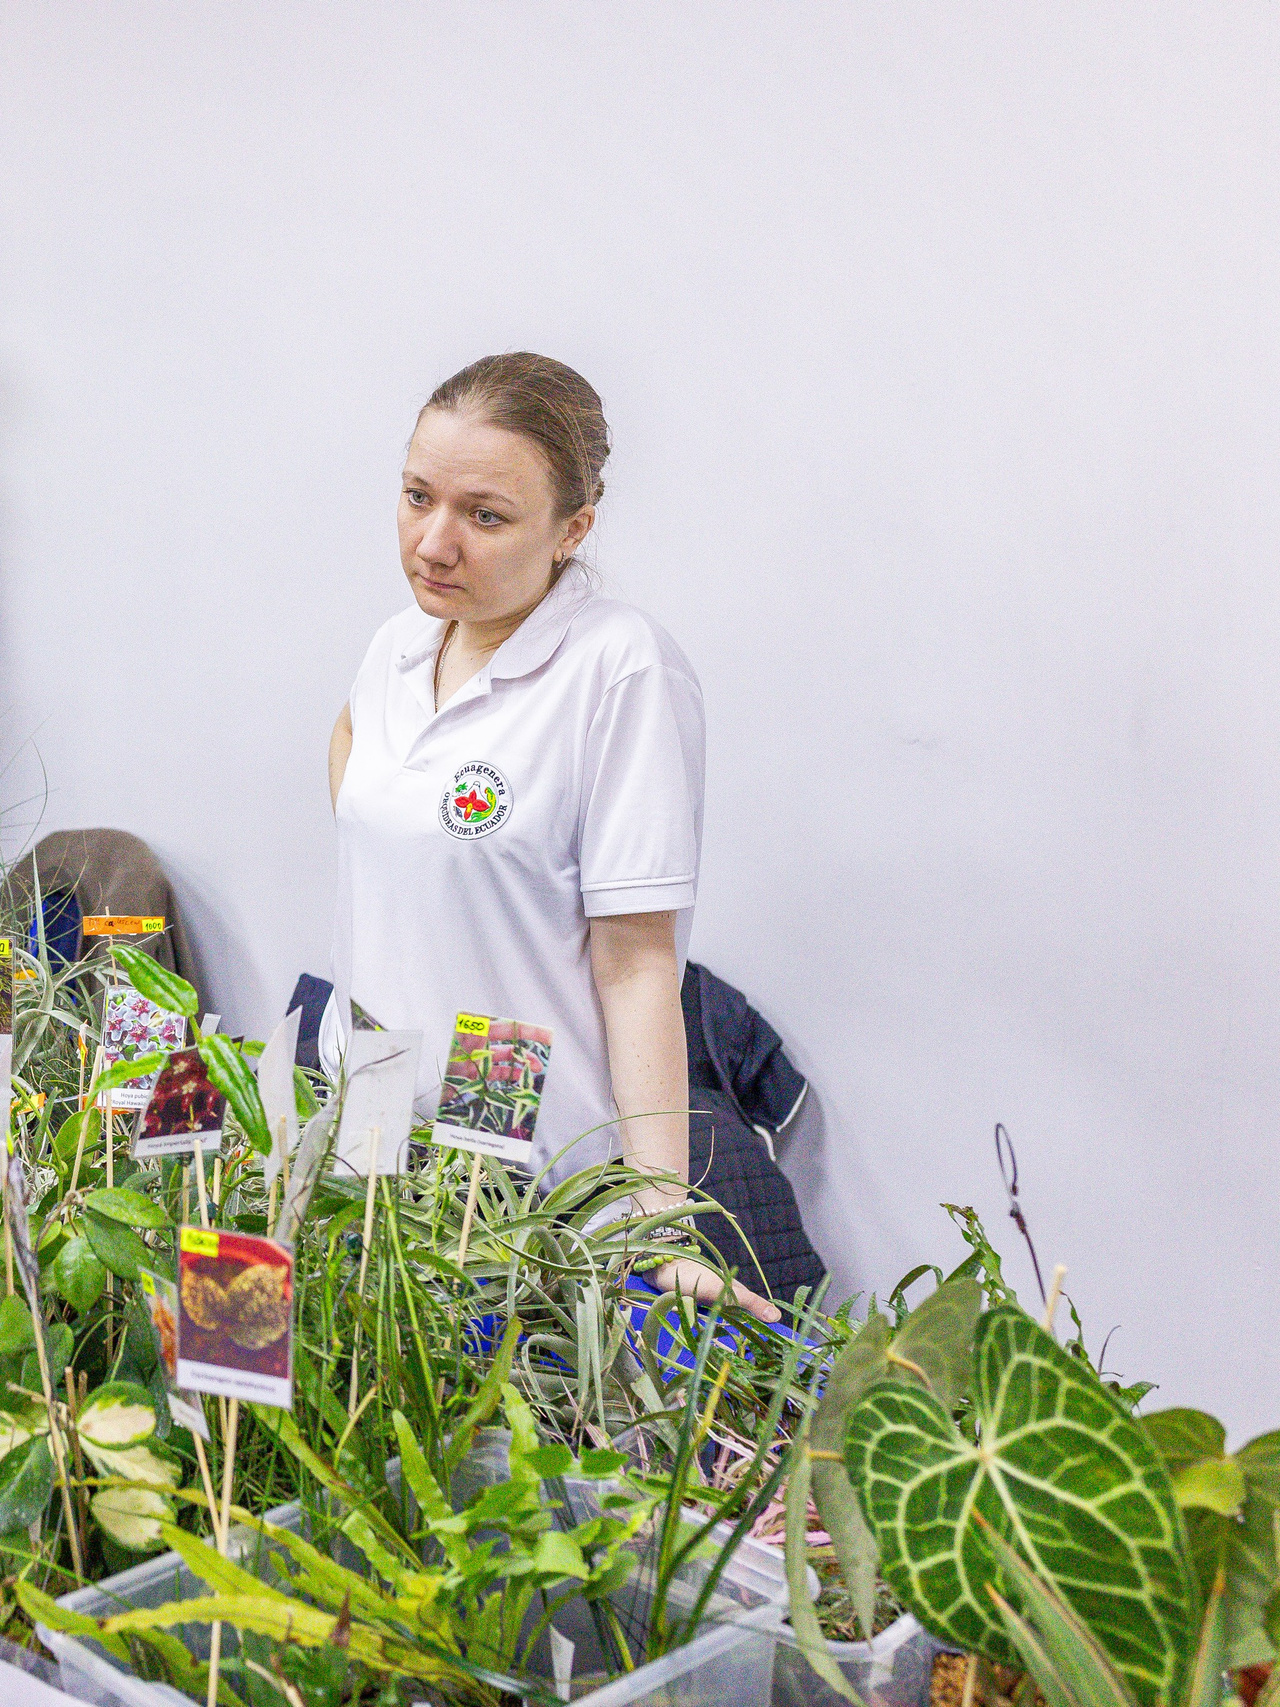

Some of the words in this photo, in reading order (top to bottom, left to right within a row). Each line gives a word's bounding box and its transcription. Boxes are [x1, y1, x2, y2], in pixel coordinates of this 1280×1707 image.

[453, 763, 507, 796] Ecuagenera
[457, 826, 474, 836] DEL
[474, 804, 508, 836] ECUADOR
[145, 921, 162, 931] 1000
[458, 1018, 486, 1032] 1650
